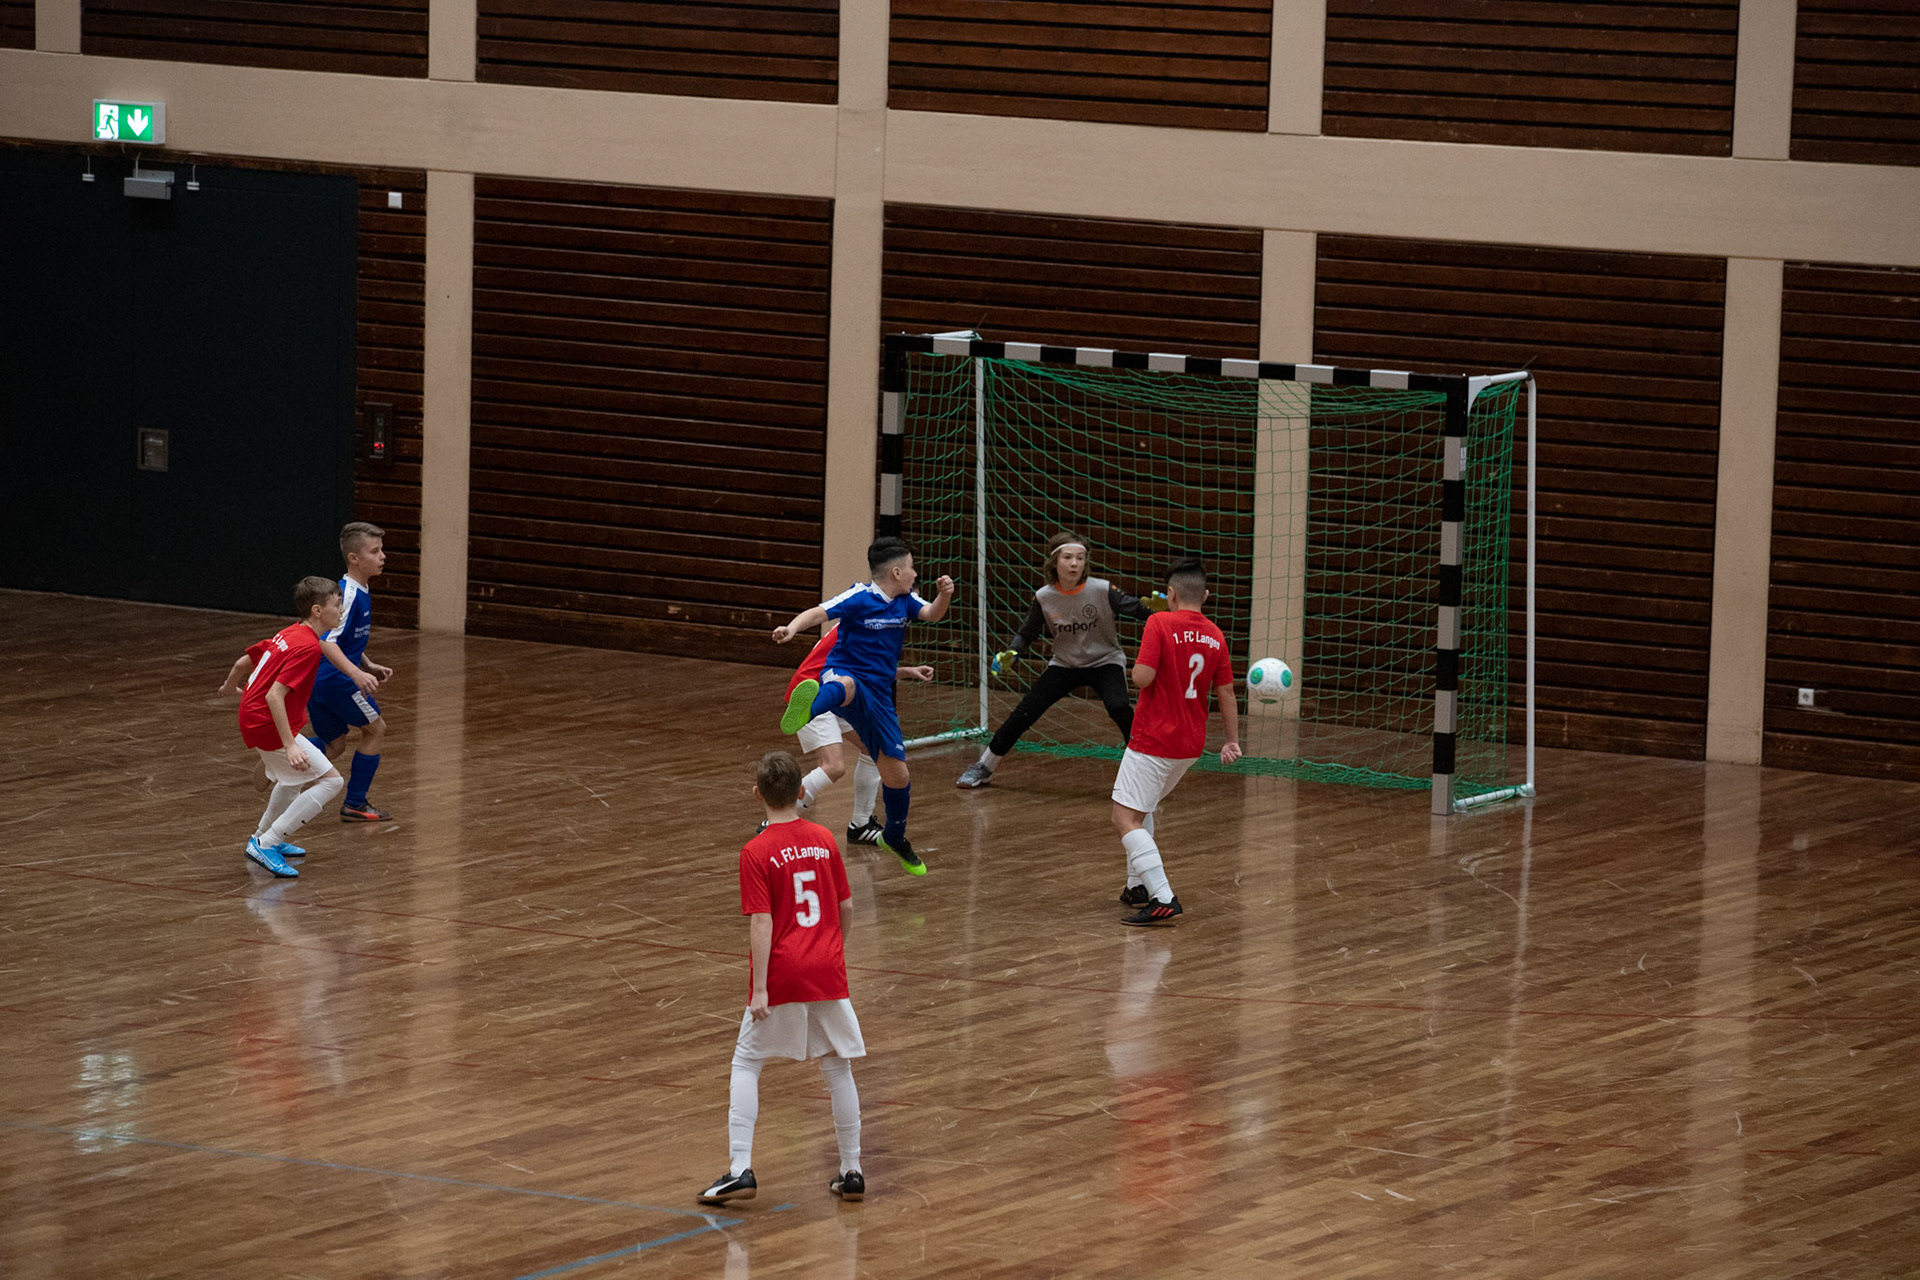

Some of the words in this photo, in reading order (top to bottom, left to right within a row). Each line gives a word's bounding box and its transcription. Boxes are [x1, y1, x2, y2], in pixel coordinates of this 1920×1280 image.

[1172, 632, 1182, 644] 1.
[1183, 630, 1194, 643] FC
[1195, 631, 1220, 650] Langen
[1184, 652, 1205, 699] 2
[769, 856, 784, 869] 1.
[780, 846, 795, 863] FC
[793, 845, 830, 861] Langen
[793, 869, 821, 928] 5
